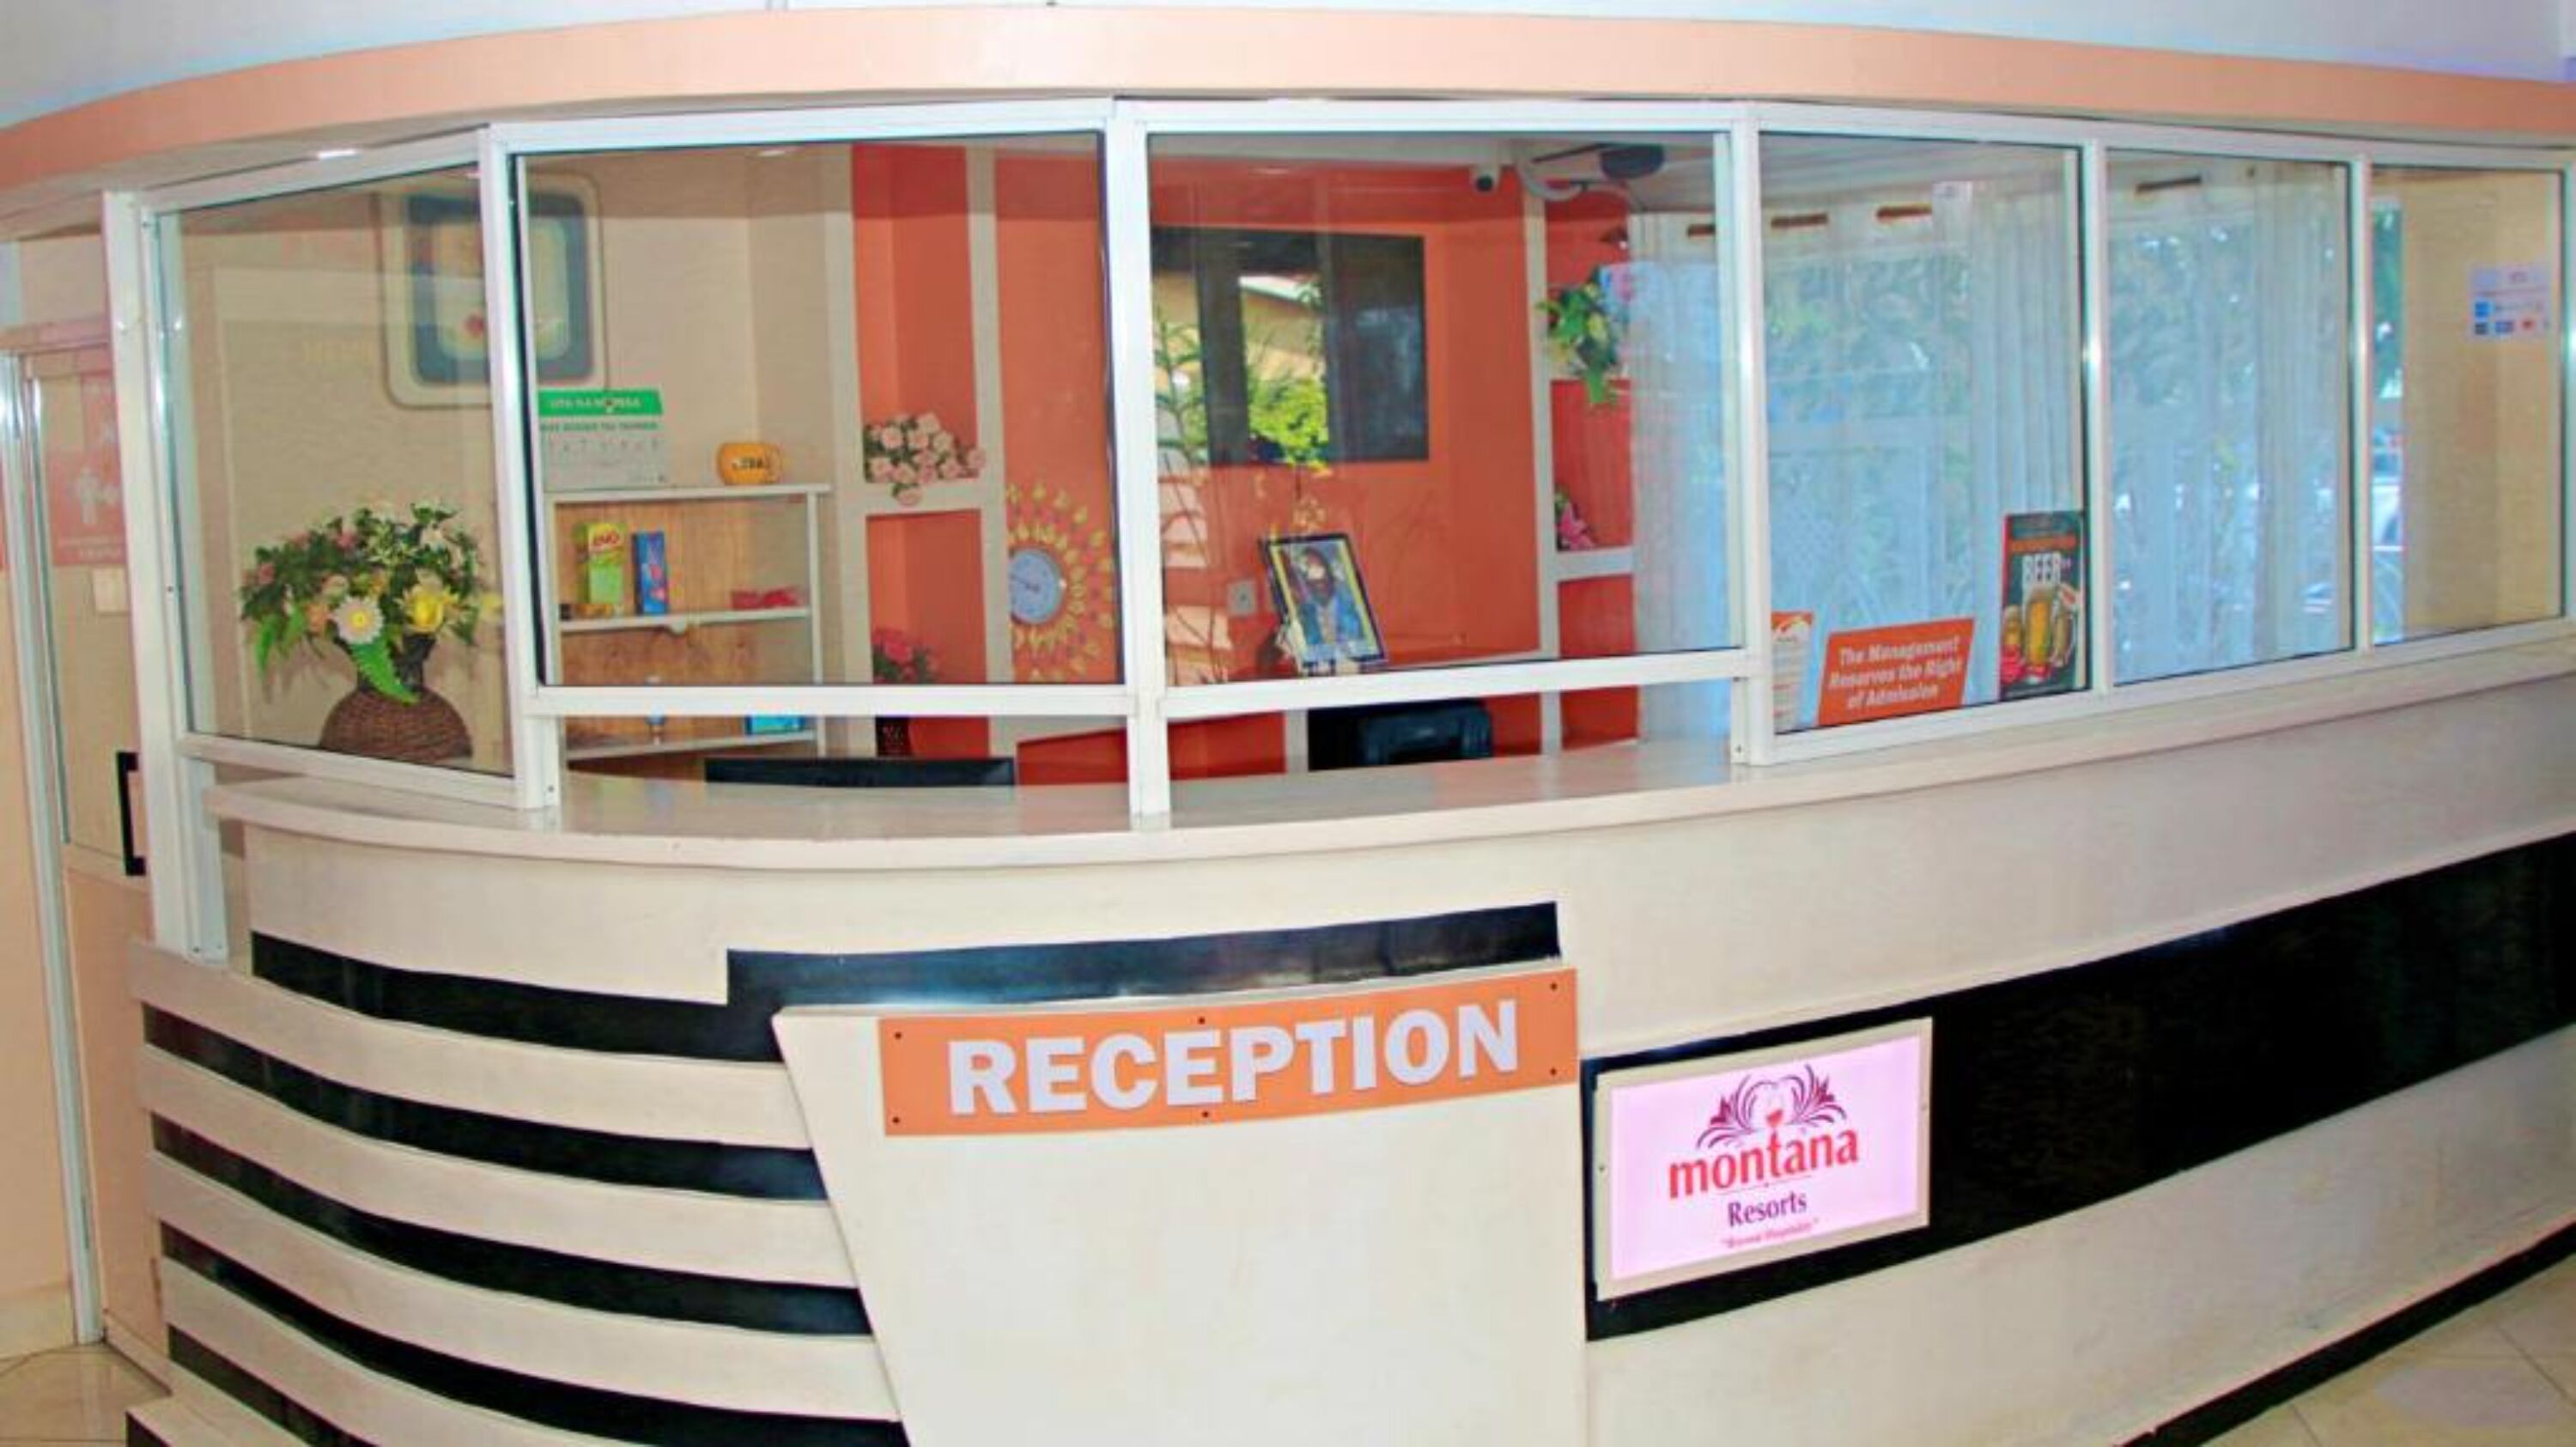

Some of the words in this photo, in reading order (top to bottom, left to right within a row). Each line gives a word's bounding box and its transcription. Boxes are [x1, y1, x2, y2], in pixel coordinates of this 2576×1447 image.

[2022, 550, 2061, 587] BEER
[1839, 646, 1865, 666] The
[1868, 635, 1960, 662] Management
[1829, 668, 1895, 690] Reserves
[1898, 661, 1923, 680] the
[1923, 656, 1963, 680] Right
[1847, 689, 1867, 710] of
[1866, 684, 1939, 707] Admission
[948, 1000, 1519, 1116] RECEPTION
[1669, 1128, 1859, 1199] montana
[1728, 1191, 1807, 1227] Resorts
